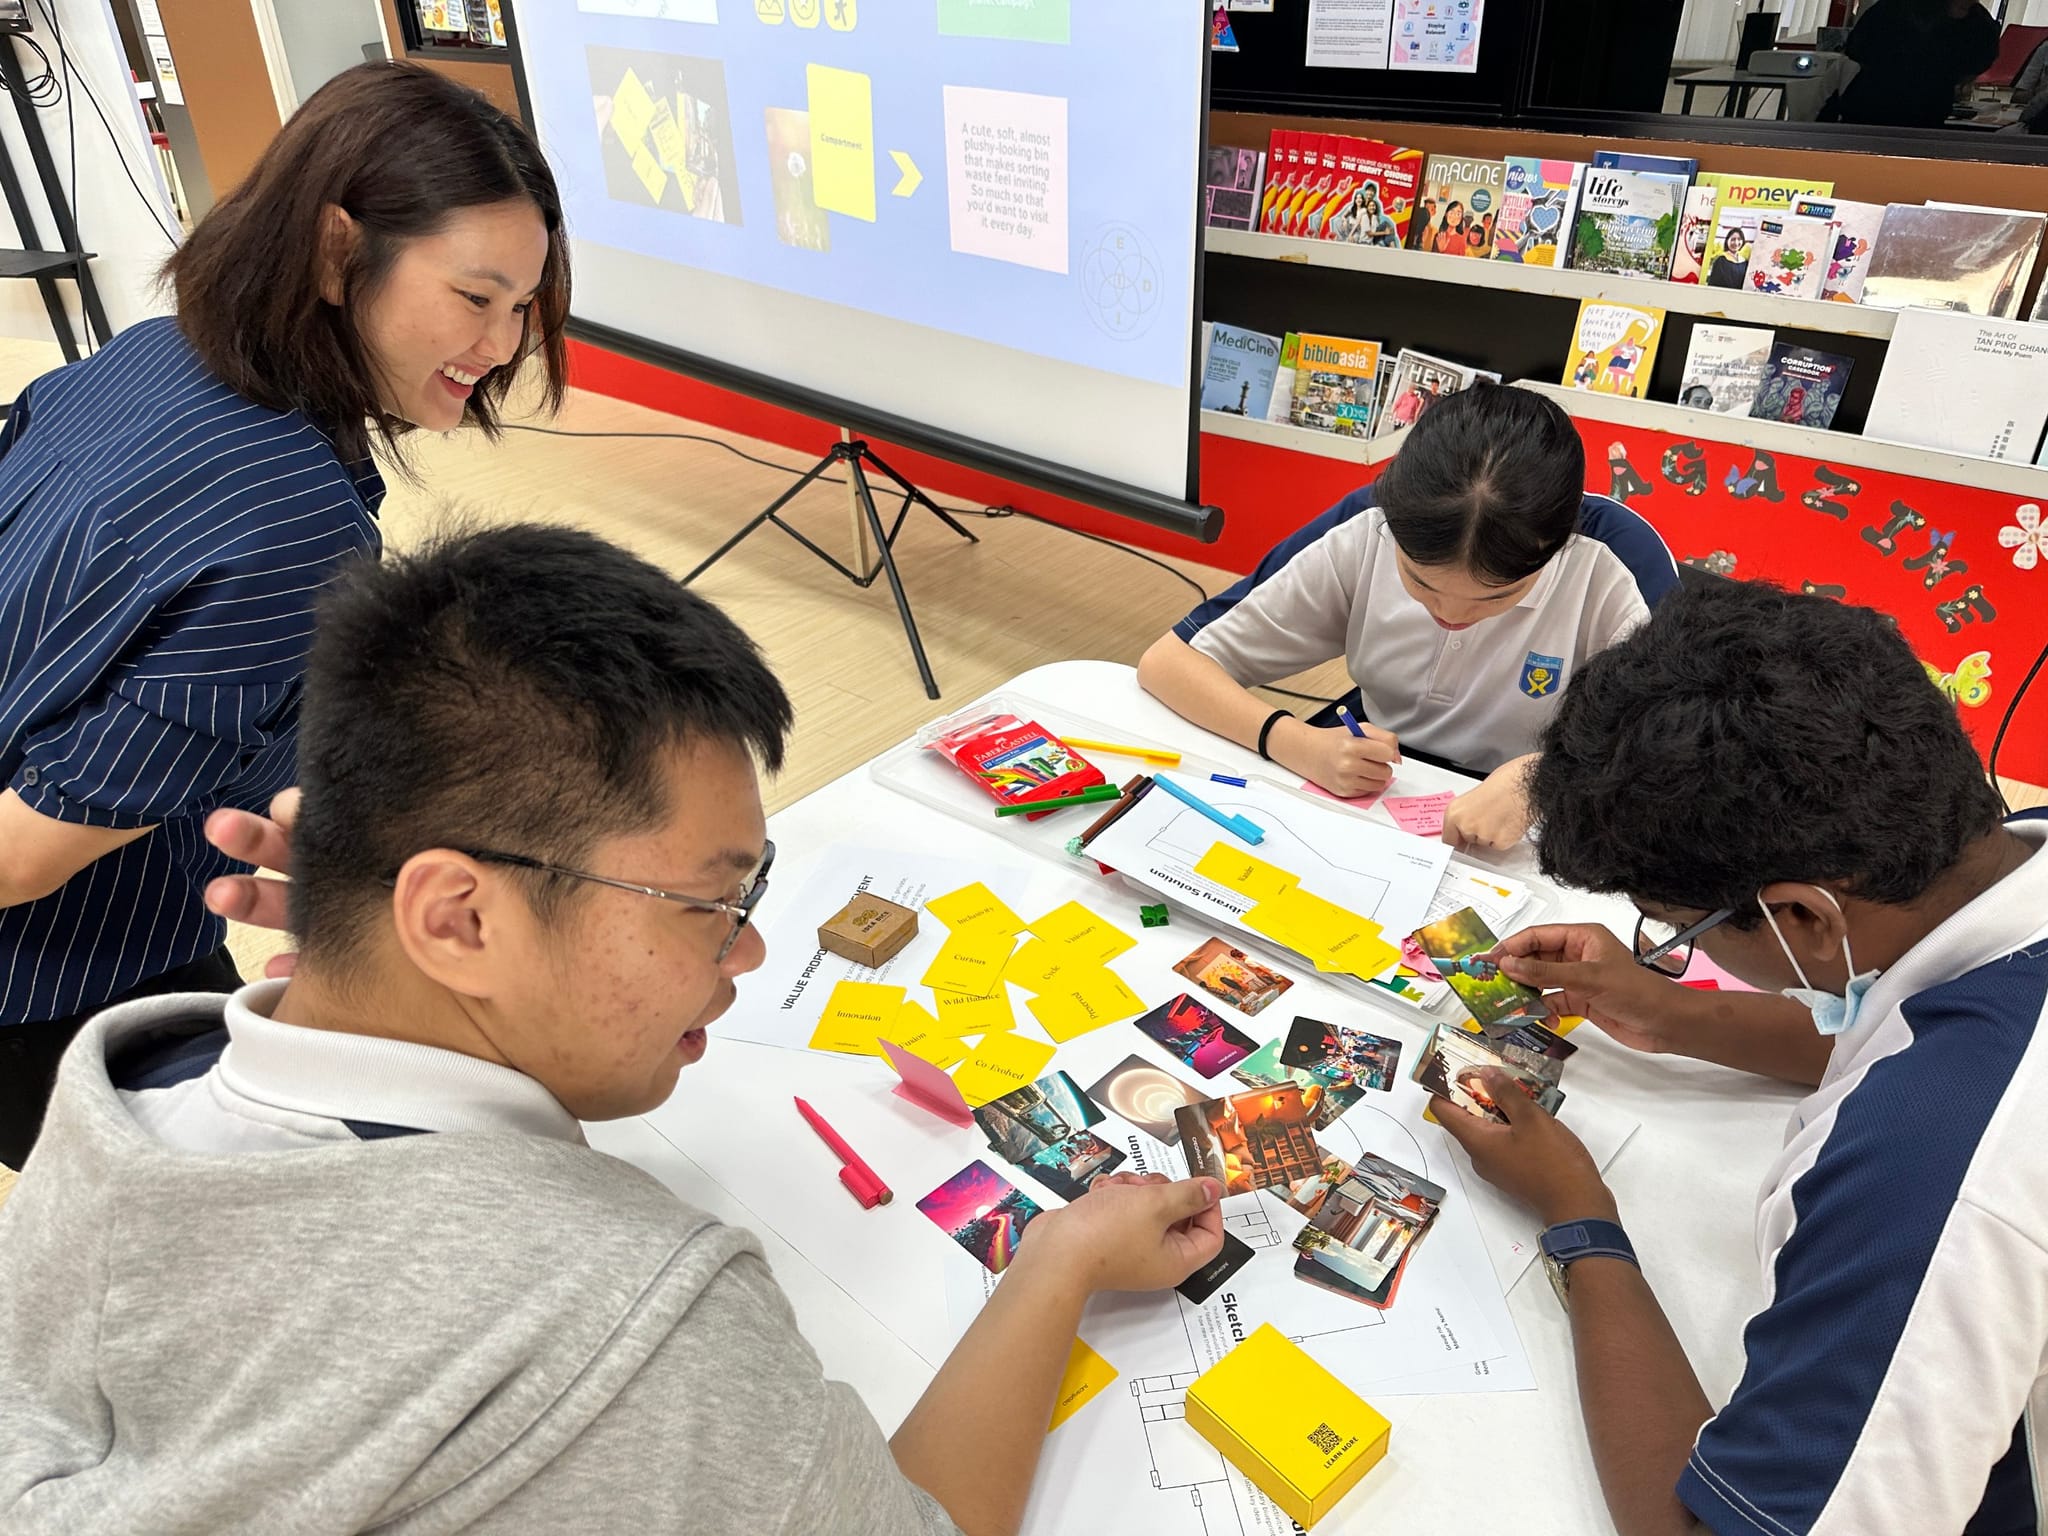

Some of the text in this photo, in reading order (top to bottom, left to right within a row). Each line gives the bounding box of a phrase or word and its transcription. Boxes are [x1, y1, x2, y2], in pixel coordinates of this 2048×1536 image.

[820, 133, 865, 151] Compartment
[962, 122, 1051, 148] A cute, soft, almost
[964, 138, 1050, 163] plushy-looking bin
[964, 153, 1051, 181] that makes sorting
[1341, 161, 1357, 172] THE
[1357, 163, 1383, 176] RIGHT
[1383, 169, 1414, 183] CHOICE
[1343, 155, 1401, 172] YOUR COURSE GUIDE TO
[1429, 161, 1502, 187] IMAGINE
[965, 170, 1050, 196] waste feel inviting.
[1588, 175, 1623, 198] life
[970, 184, 1045, 209] So much so that
[1592, 196, 1630, 209] storeys
[966, 200, 1050, 225] you'd want to visit
[982, 216, 1037, 240] it every day.
[1584, 318, 1622, 329] ANOTHER
[1979, 329, 2018, 341] The Art Of
[1214, 329, 1275, 357] MediCine
[1974, 345, 1991, 353] Lines
[2003, 350, 2014, 358] My
[1976, 337, 2048, 354] TAN PING CHIAN
[1303, 343, 1367, 369] biblioasia
[1781, 356, 1832, 373] CORRUPTION
[1408, 363, 1454, 393] HEY!
[1787, 365, 1821, 377] CASEBOOK
[1337, 403, 1354, 418] 50
[1149, 867, 1201, 896] Solution
[953, 953, 987, 966] Curious
[780, 980, 809, 1010] VALUE
[943, 997, 965, 1007] Wild
[836, 1010, 882, 1022] Innovation
[1127, 1135, 1149, 1177] olution
[1323, 1436, 1360, 1469] LEARN MORE
